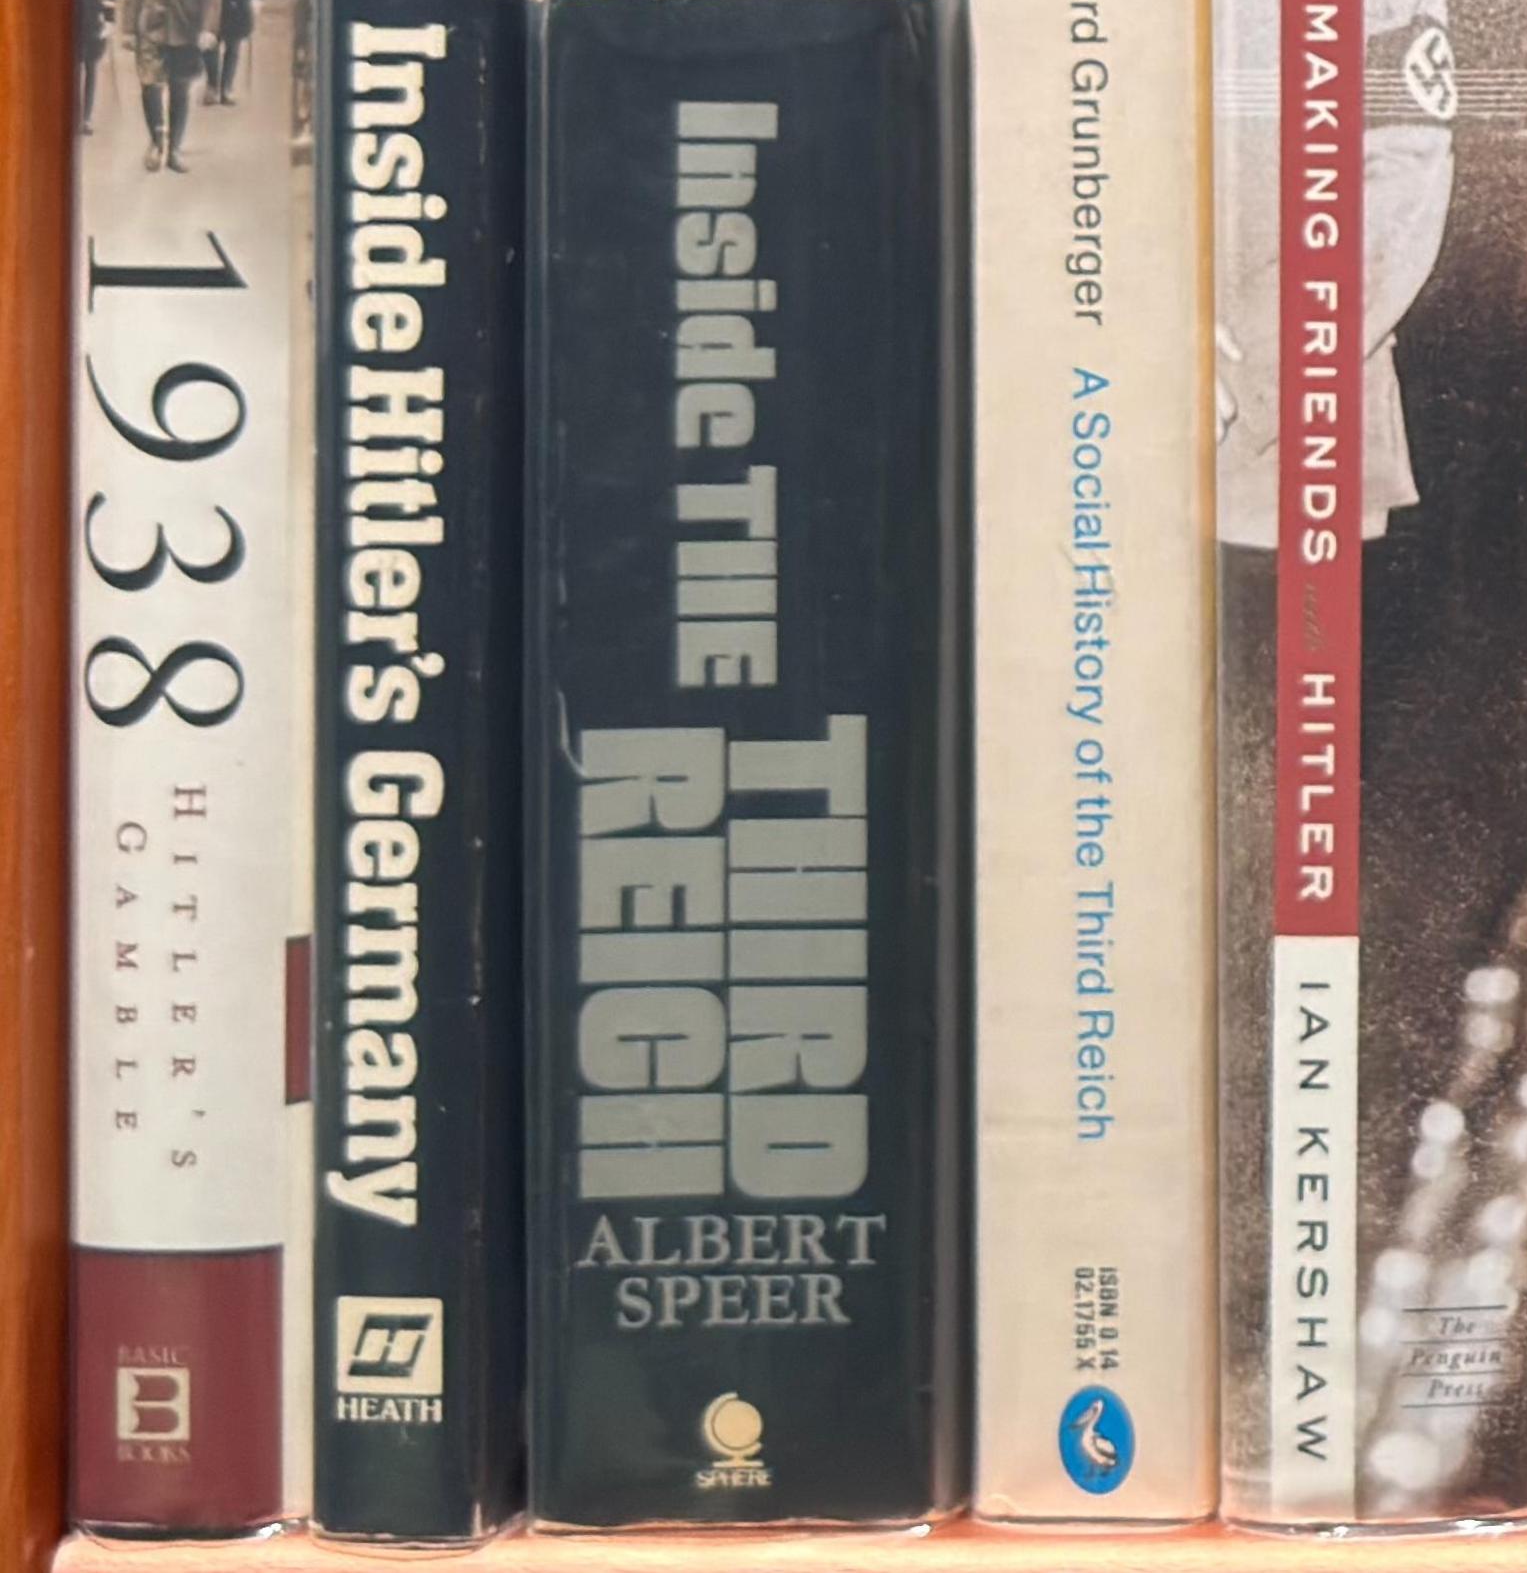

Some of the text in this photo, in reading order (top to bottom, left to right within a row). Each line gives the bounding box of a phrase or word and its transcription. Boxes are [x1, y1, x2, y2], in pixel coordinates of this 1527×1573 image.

[1064, 58, 1109, 323] Grunberger
[1304, 3, 1340, 251] MAKING
[84, 229, 249, 728] 1938
[674, 101, 778, 688] Inside THE
[1071, 366, 1110, 401] A
[1072, 411, 1112, 550] Social
[1302, 282, 1337, 564] FRIENDS
[327, 22, 447, 1225] Inside Hitler's Germany
[1066, 565, 1115, 726] History
[1073, 740, 1115, 786] of
[1073, 796, 1115, 867] the
[1301, 672, 1336, 901] HITLER
[114, 822, 148, 1134] GAMBLE
[172, 784, 207, 1172] HITLER'S
[578, 728, 726, 1198] REICH
[728, 713, 869, 1198] THIRD
[1073, 880, 1115, 995] Third
[1073, 1008, 1115, 1140] Reich
[578, 1215, 887, 1268] ALBERT
[616, 1275, 849, 1329] SPEER
[1098, 1267, 1120, 1369] ISBN 0 14
[1294, 982, 1332, 1461] IAN KERSHAW
[337, 1394, 443, 1423] HEATH
[1076, 1356, 1096, 1370] X
